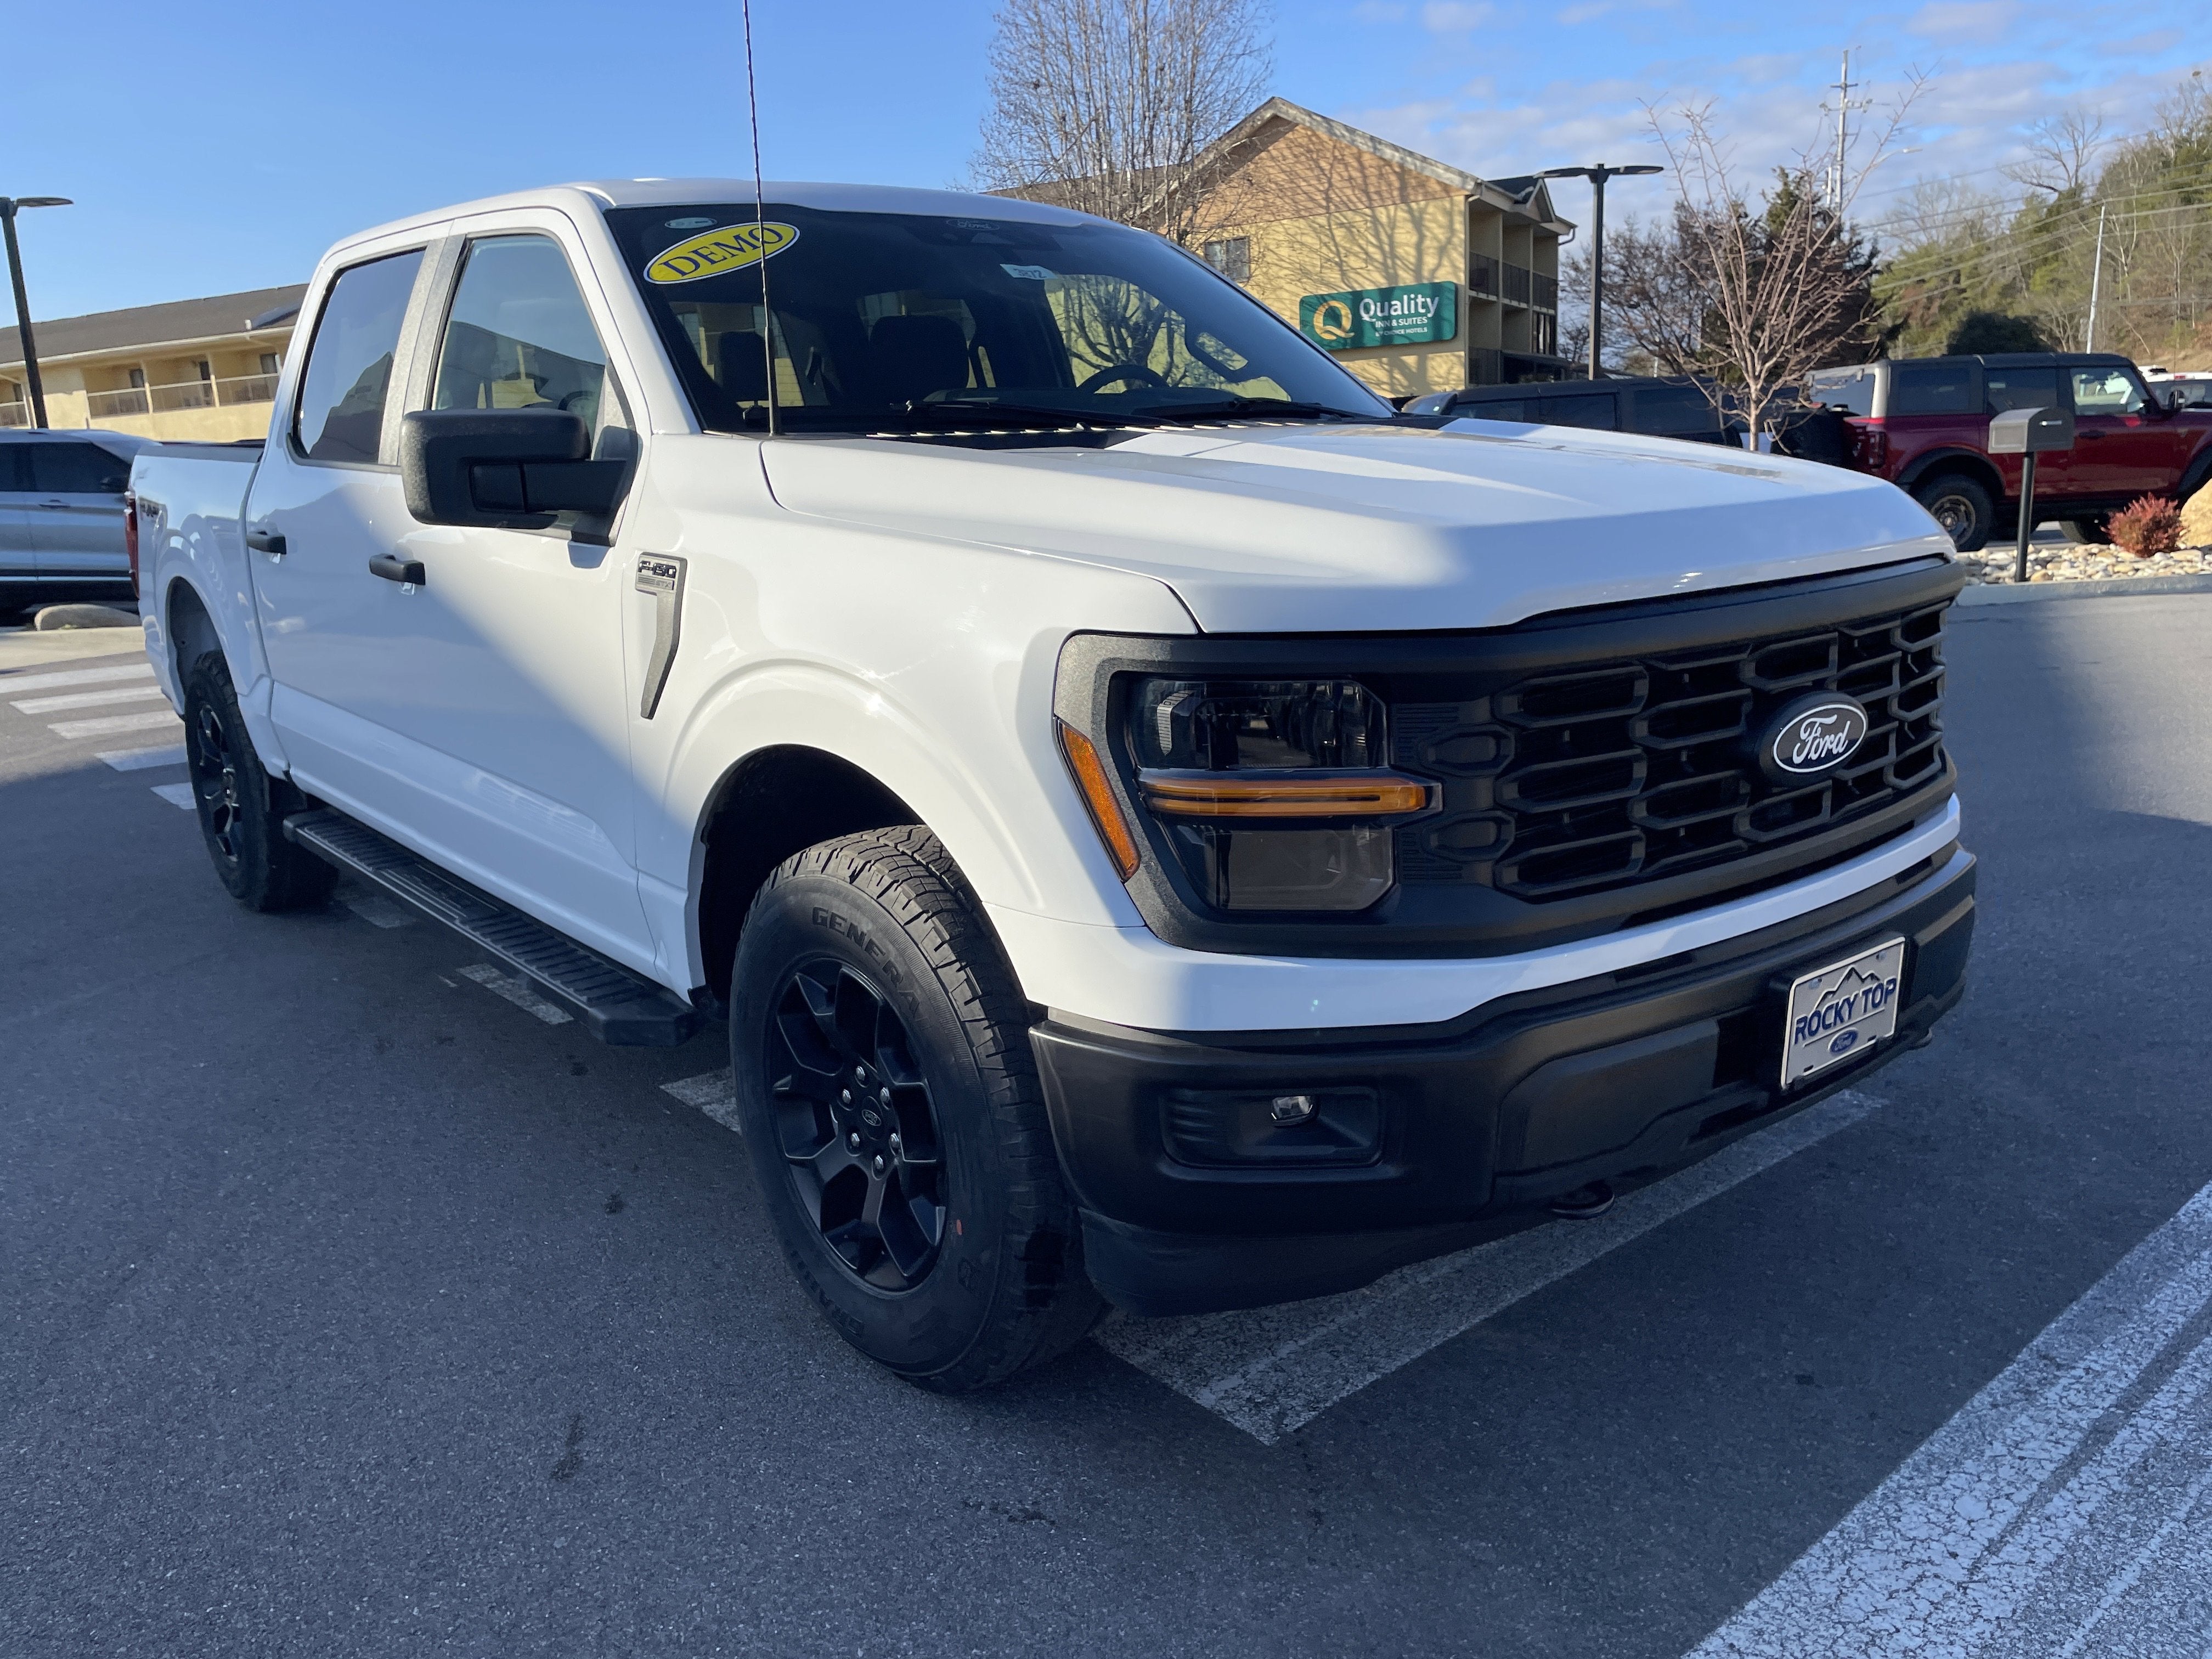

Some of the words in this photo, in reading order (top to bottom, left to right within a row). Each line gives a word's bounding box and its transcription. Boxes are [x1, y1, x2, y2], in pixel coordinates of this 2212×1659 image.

[658, 227, 783, 276] DEMO
[1359, 294, 1440, 322] Quality
[1375, 320, 1390, 328] INN
[1398, 316, 1428, 326] SUITES
[1792, 714, 1851, 764] Ford
[812, 906, 932, 1030] GENERAL
[1794, 994, 1859, 1045] ROCKY
[1861, 978, 1897, 1013] TOP
